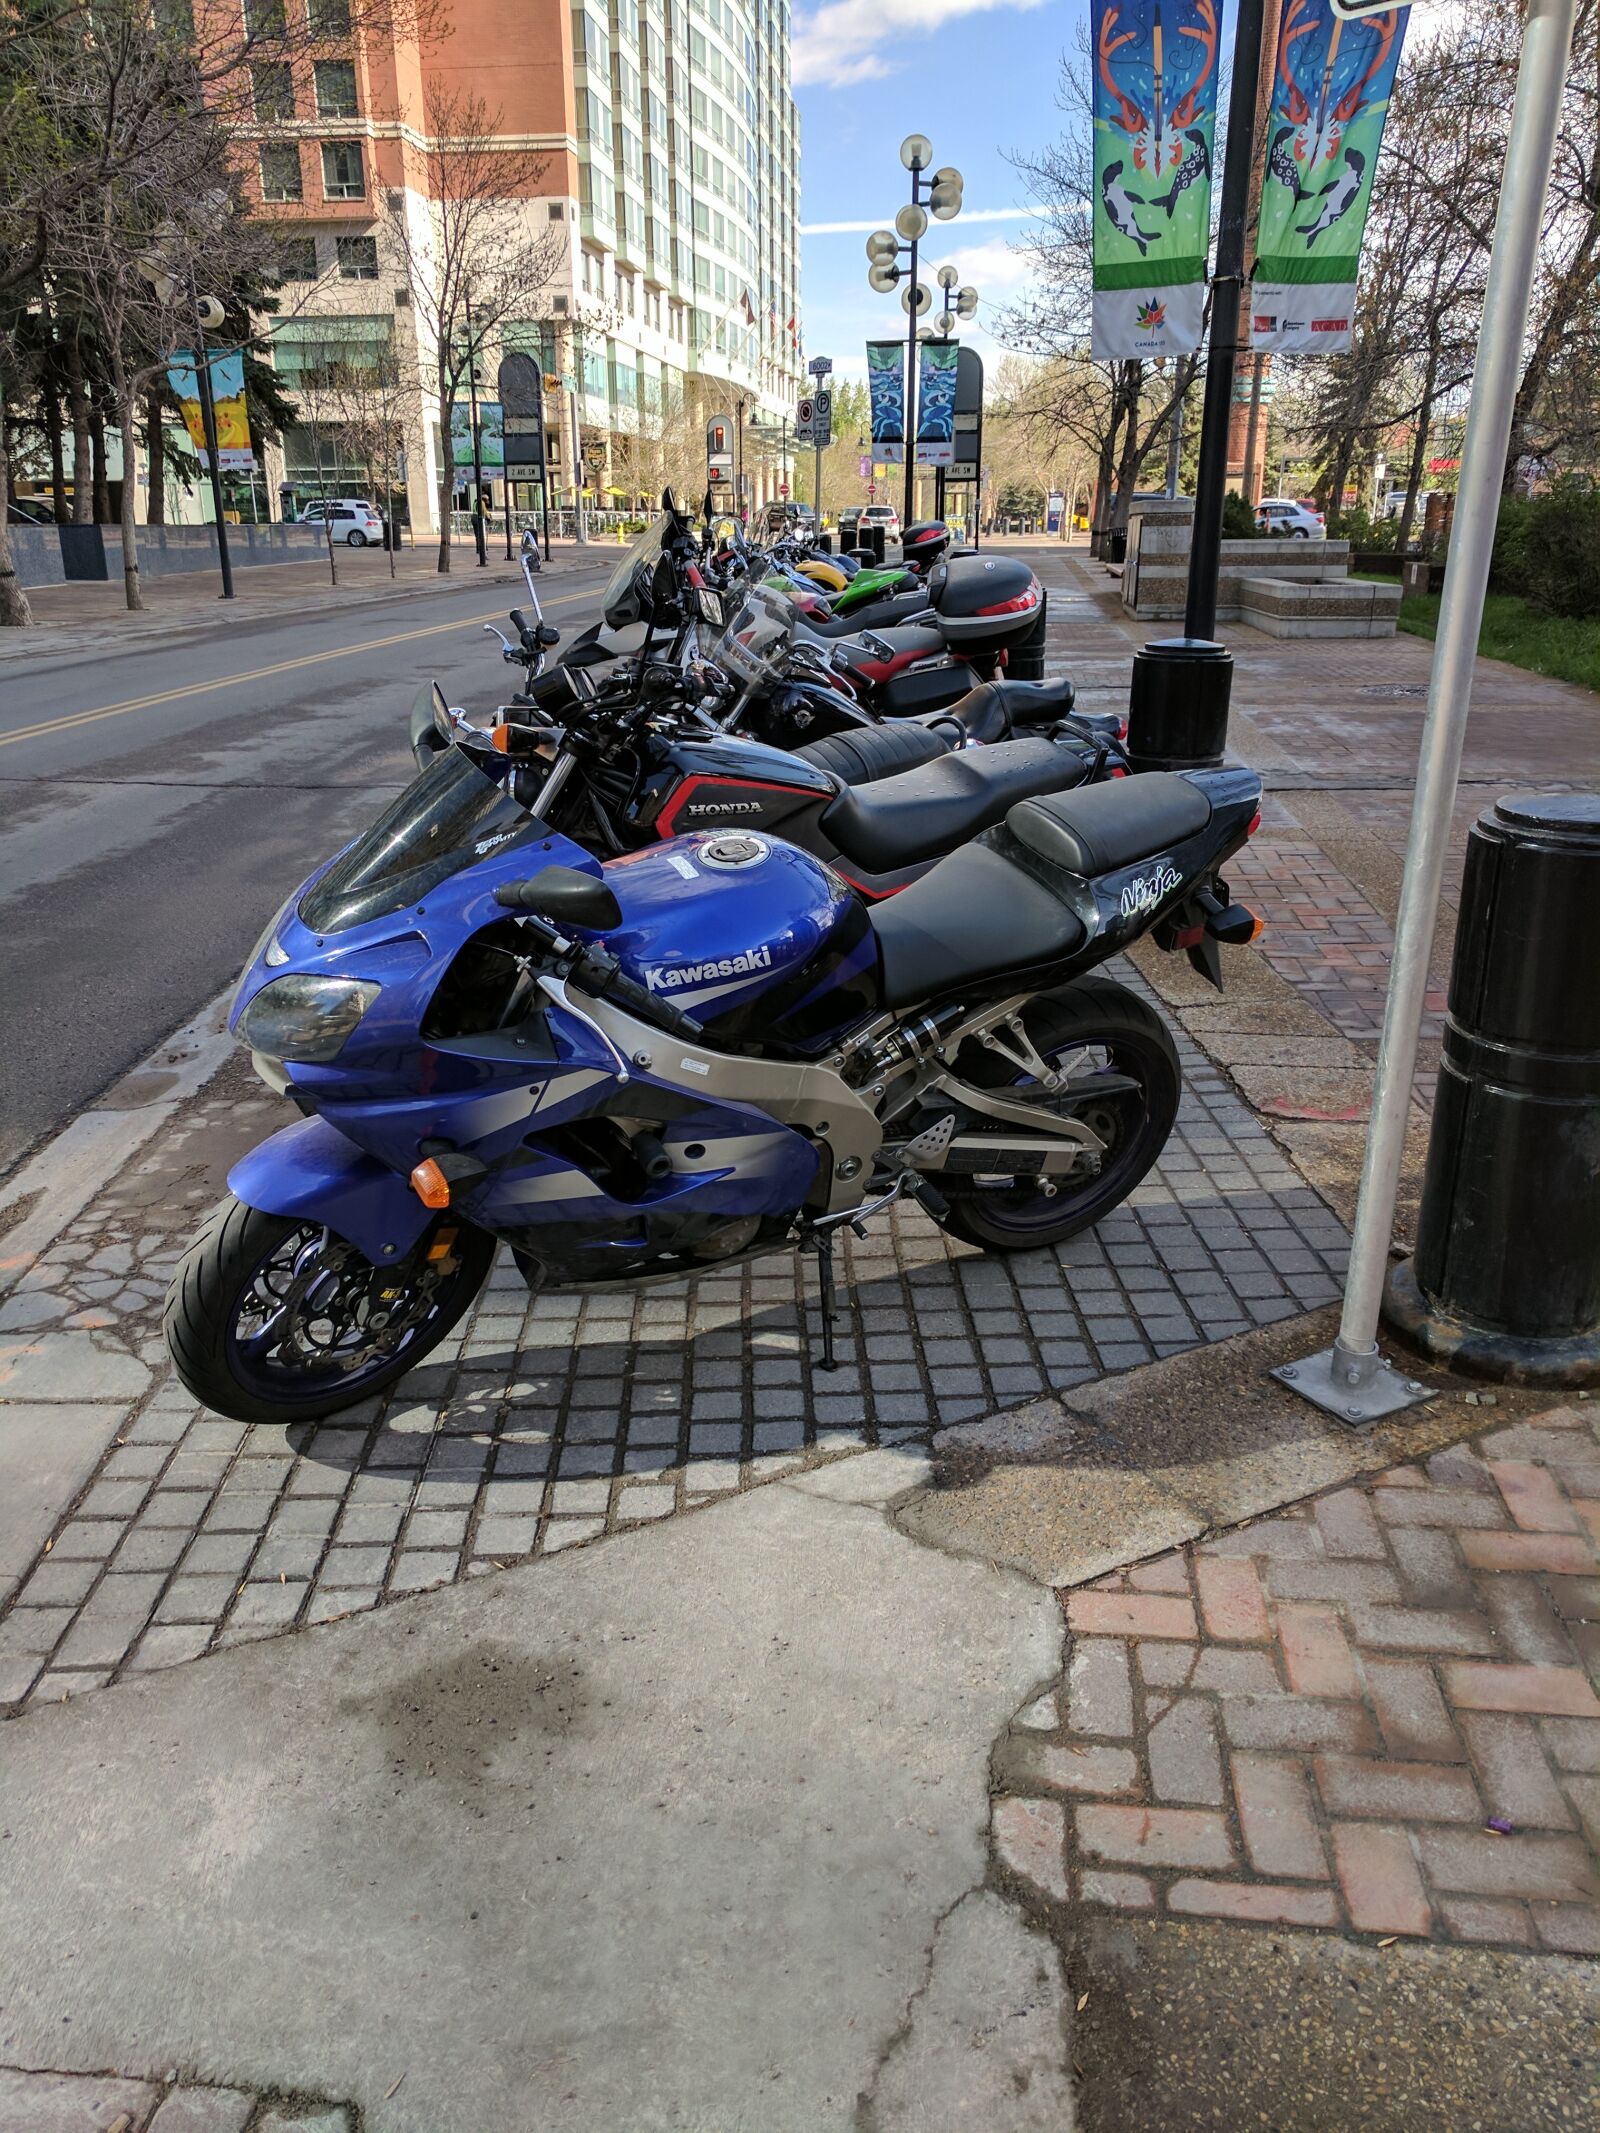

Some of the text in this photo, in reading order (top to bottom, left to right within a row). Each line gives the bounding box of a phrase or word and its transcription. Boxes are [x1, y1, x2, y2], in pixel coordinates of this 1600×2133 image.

[688, 802, 764, 816] HONDA
[1121, 865, 1183, 917] Ninja
[644, 945, 772, 991] Kawasaki
